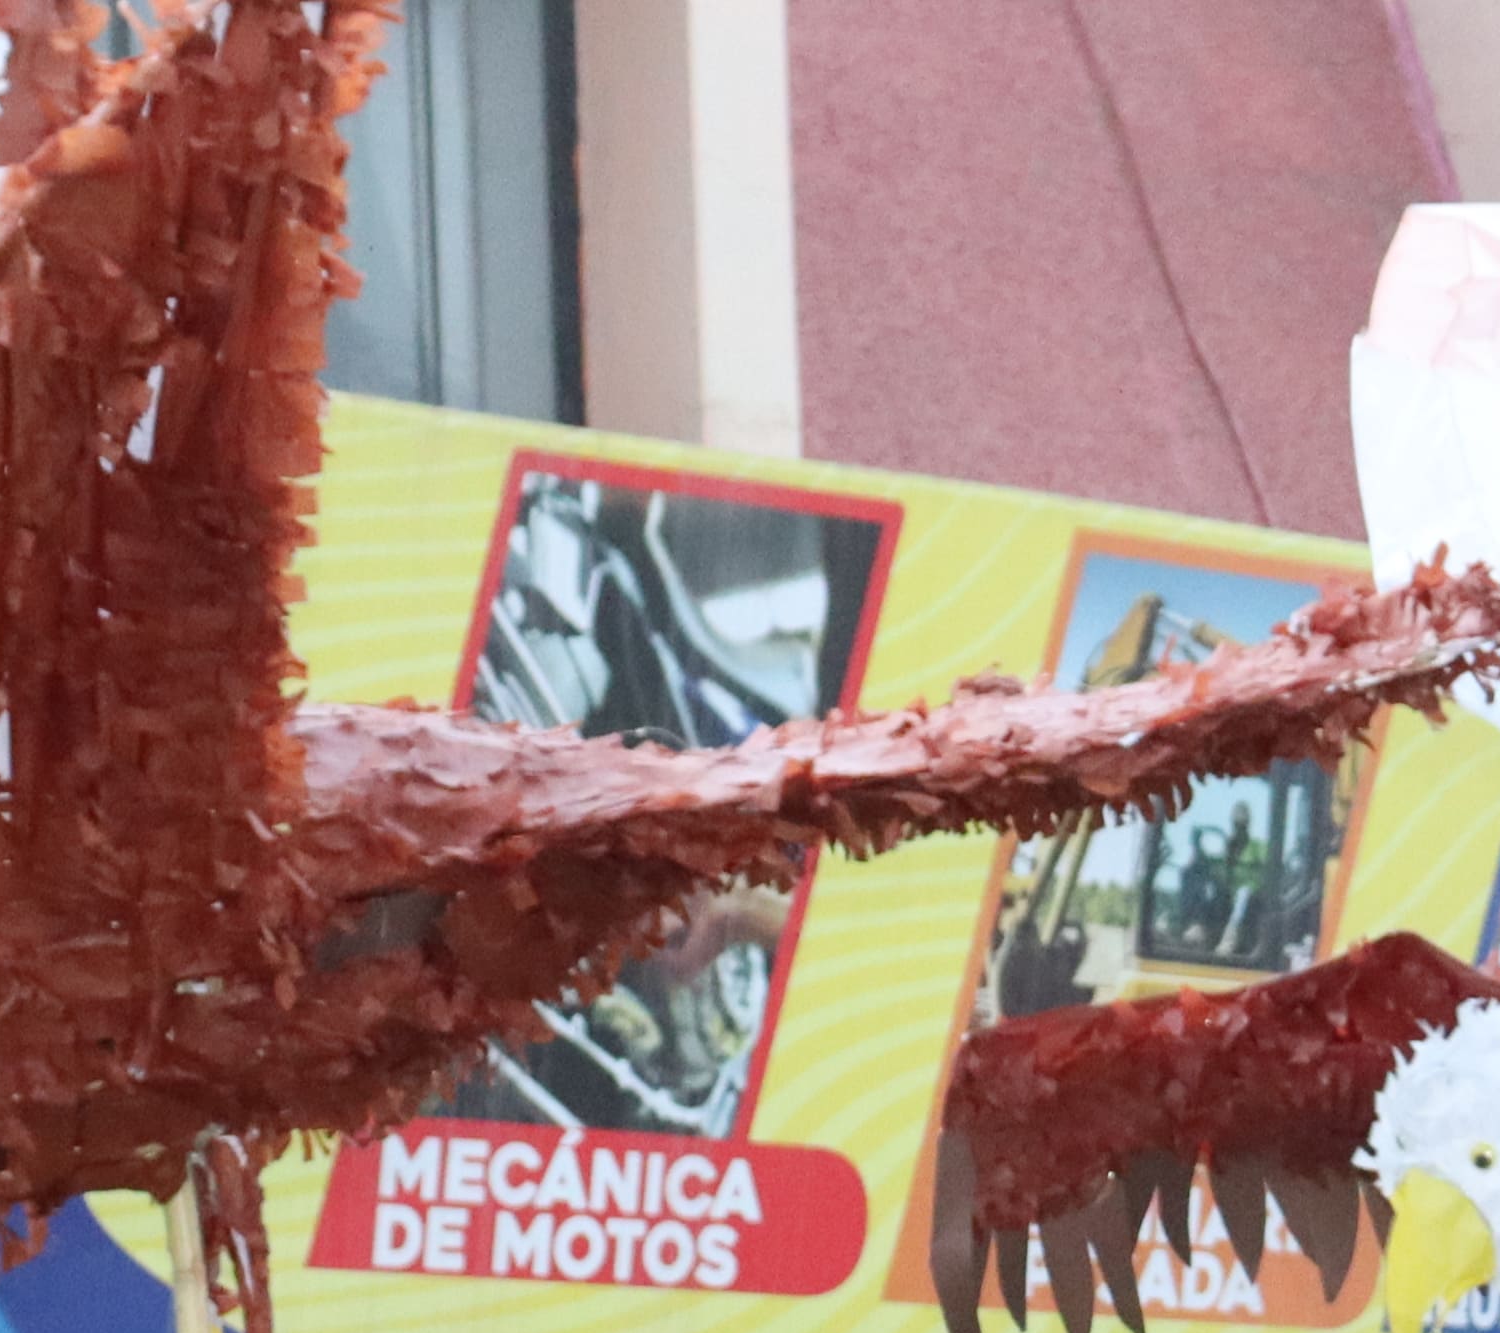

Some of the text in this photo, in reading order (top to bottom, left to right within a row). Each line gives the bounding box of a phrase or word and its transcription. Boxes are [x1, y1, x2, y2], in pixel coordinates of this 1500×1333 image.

[377, 1125, 763, 1223] MECÁNICA
[371, 1202, 739, 1288] DE MOTOS
